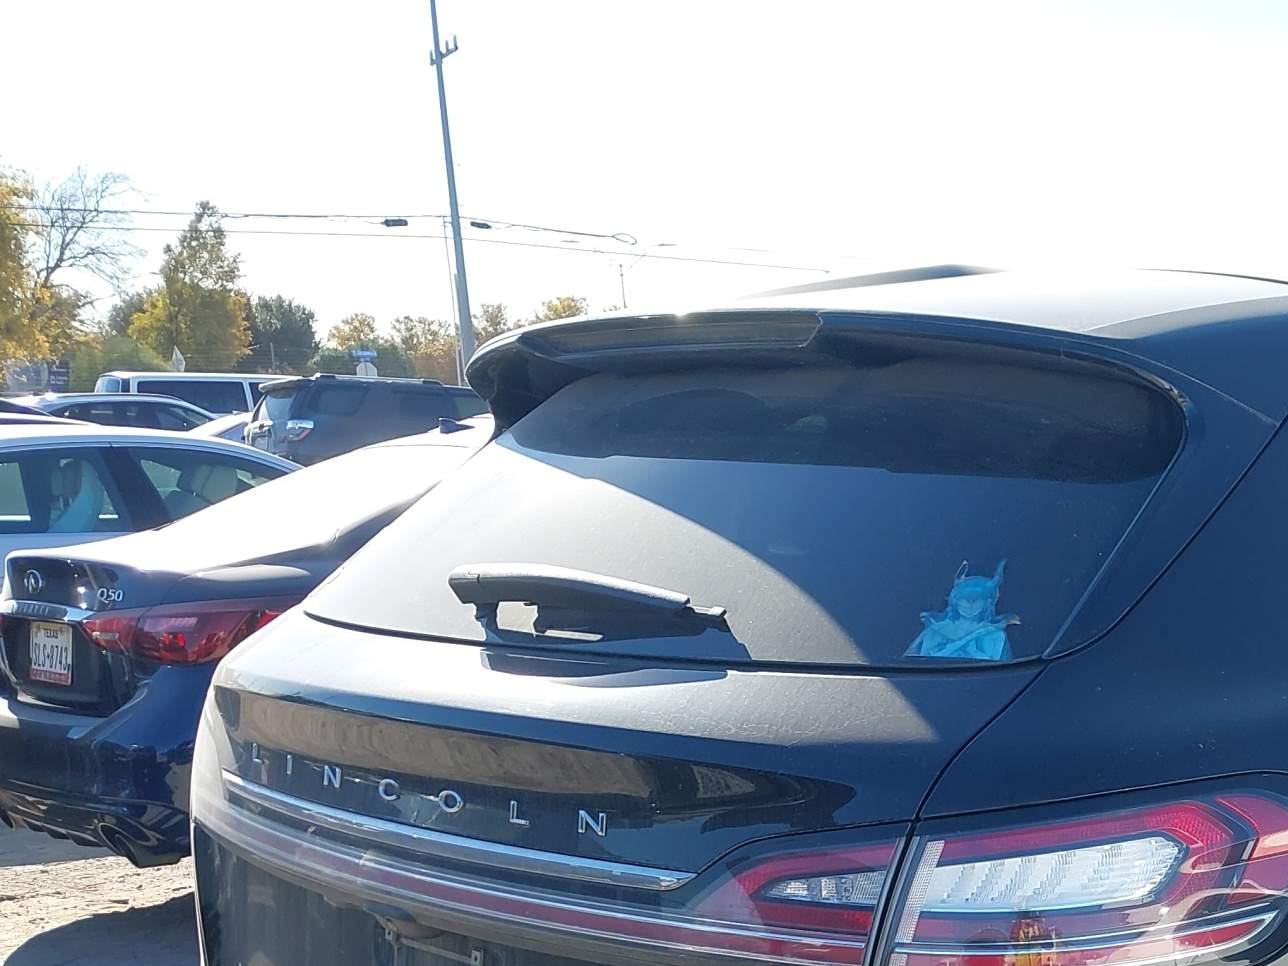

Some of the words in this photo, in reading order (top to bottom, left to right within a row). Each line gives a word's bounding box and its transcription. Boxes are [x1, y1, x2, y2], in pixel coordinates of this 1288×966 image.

[97, 588, 123, 603] Q50
[44, 628, 59, 639] TEXAS
[252, 742, 607, 837] LINCOLN
